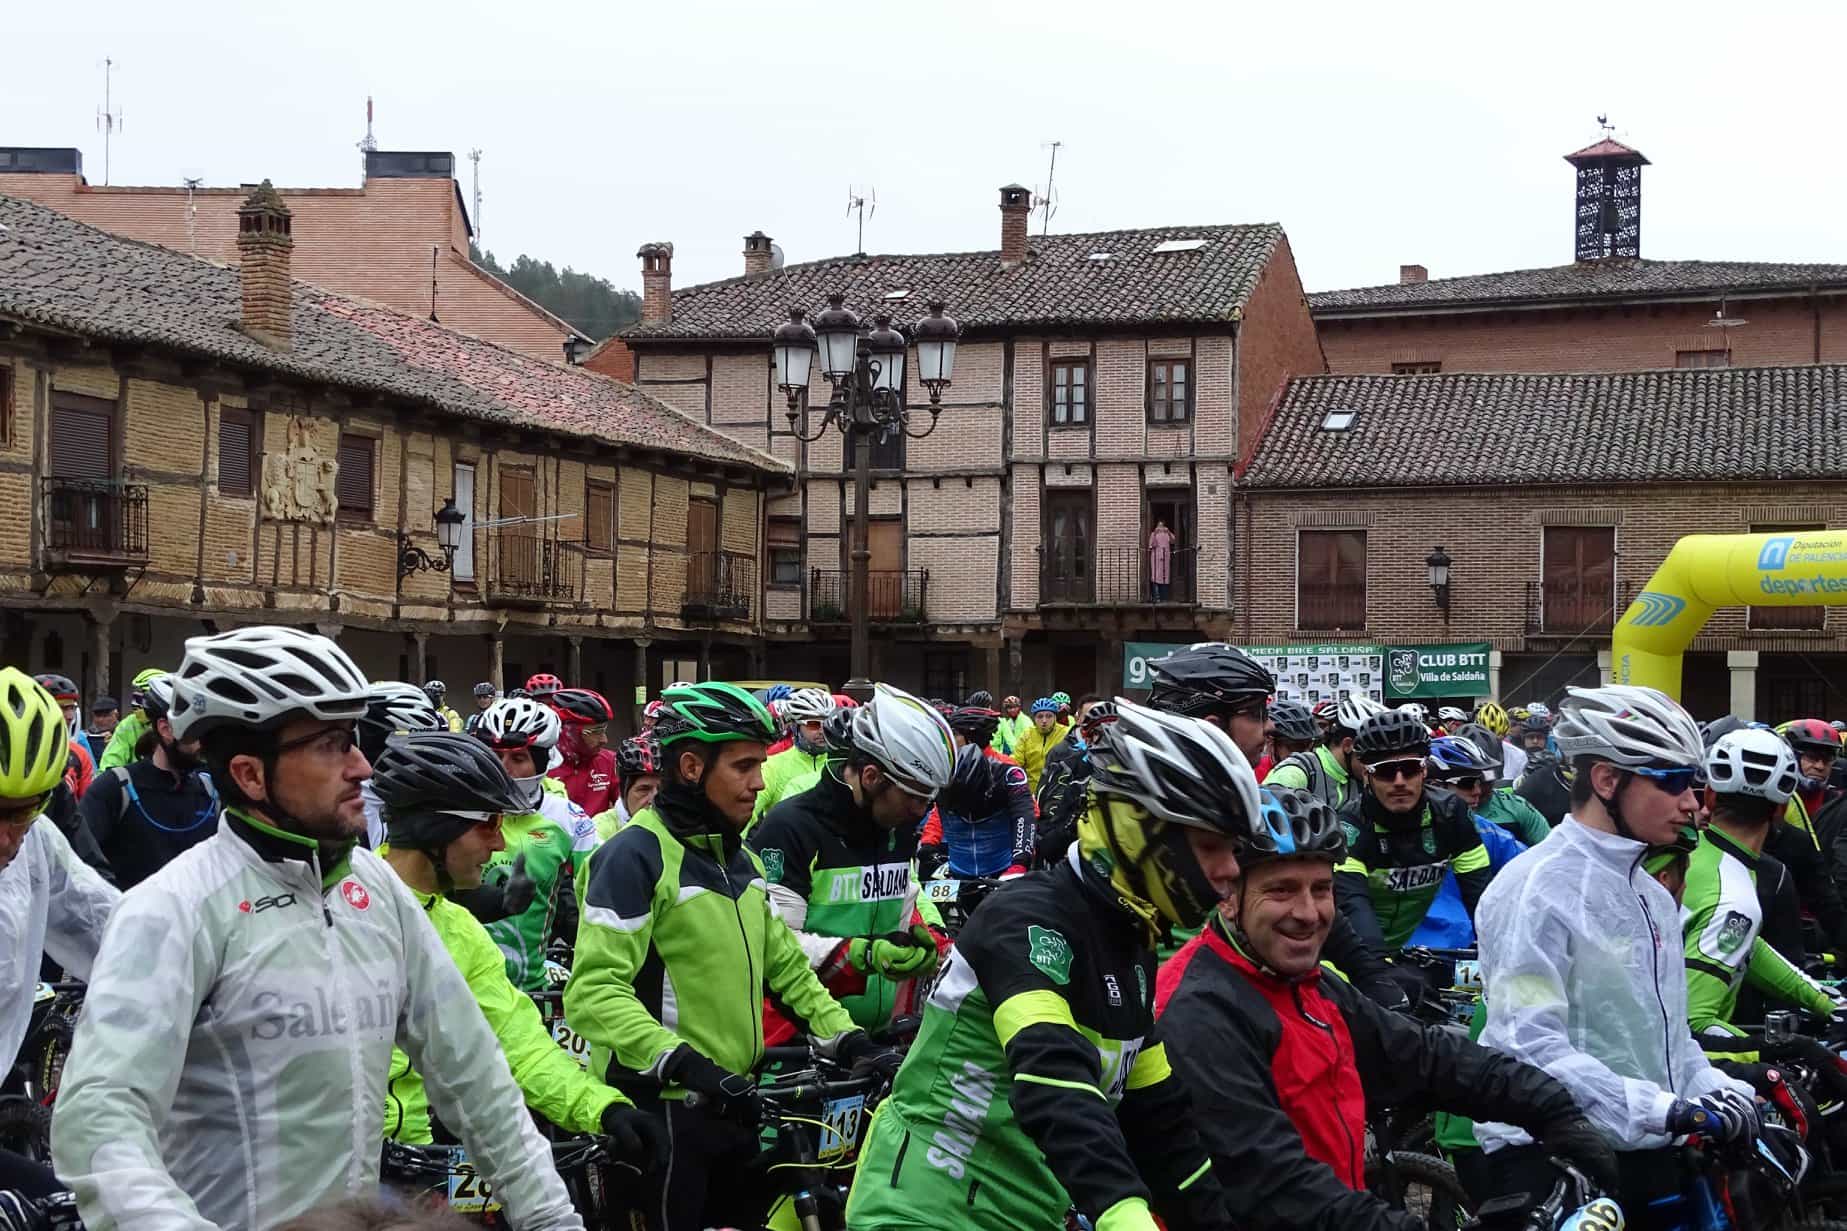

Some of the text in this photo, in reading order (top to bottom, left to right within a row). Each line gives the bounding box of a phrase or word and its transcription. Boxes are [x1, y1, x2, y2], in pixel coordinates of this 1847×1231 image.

[1287, 647, 1313, 655] BIKE
[1420, 653, 1486, 667] CLUB BTT
[1420, 670, 1486, 682] Villa de Saldaña
[931, 885, 951, 898] 88
[557, 1026, 591, 1056] 20
[824, 1110, 858, 1145] 113
